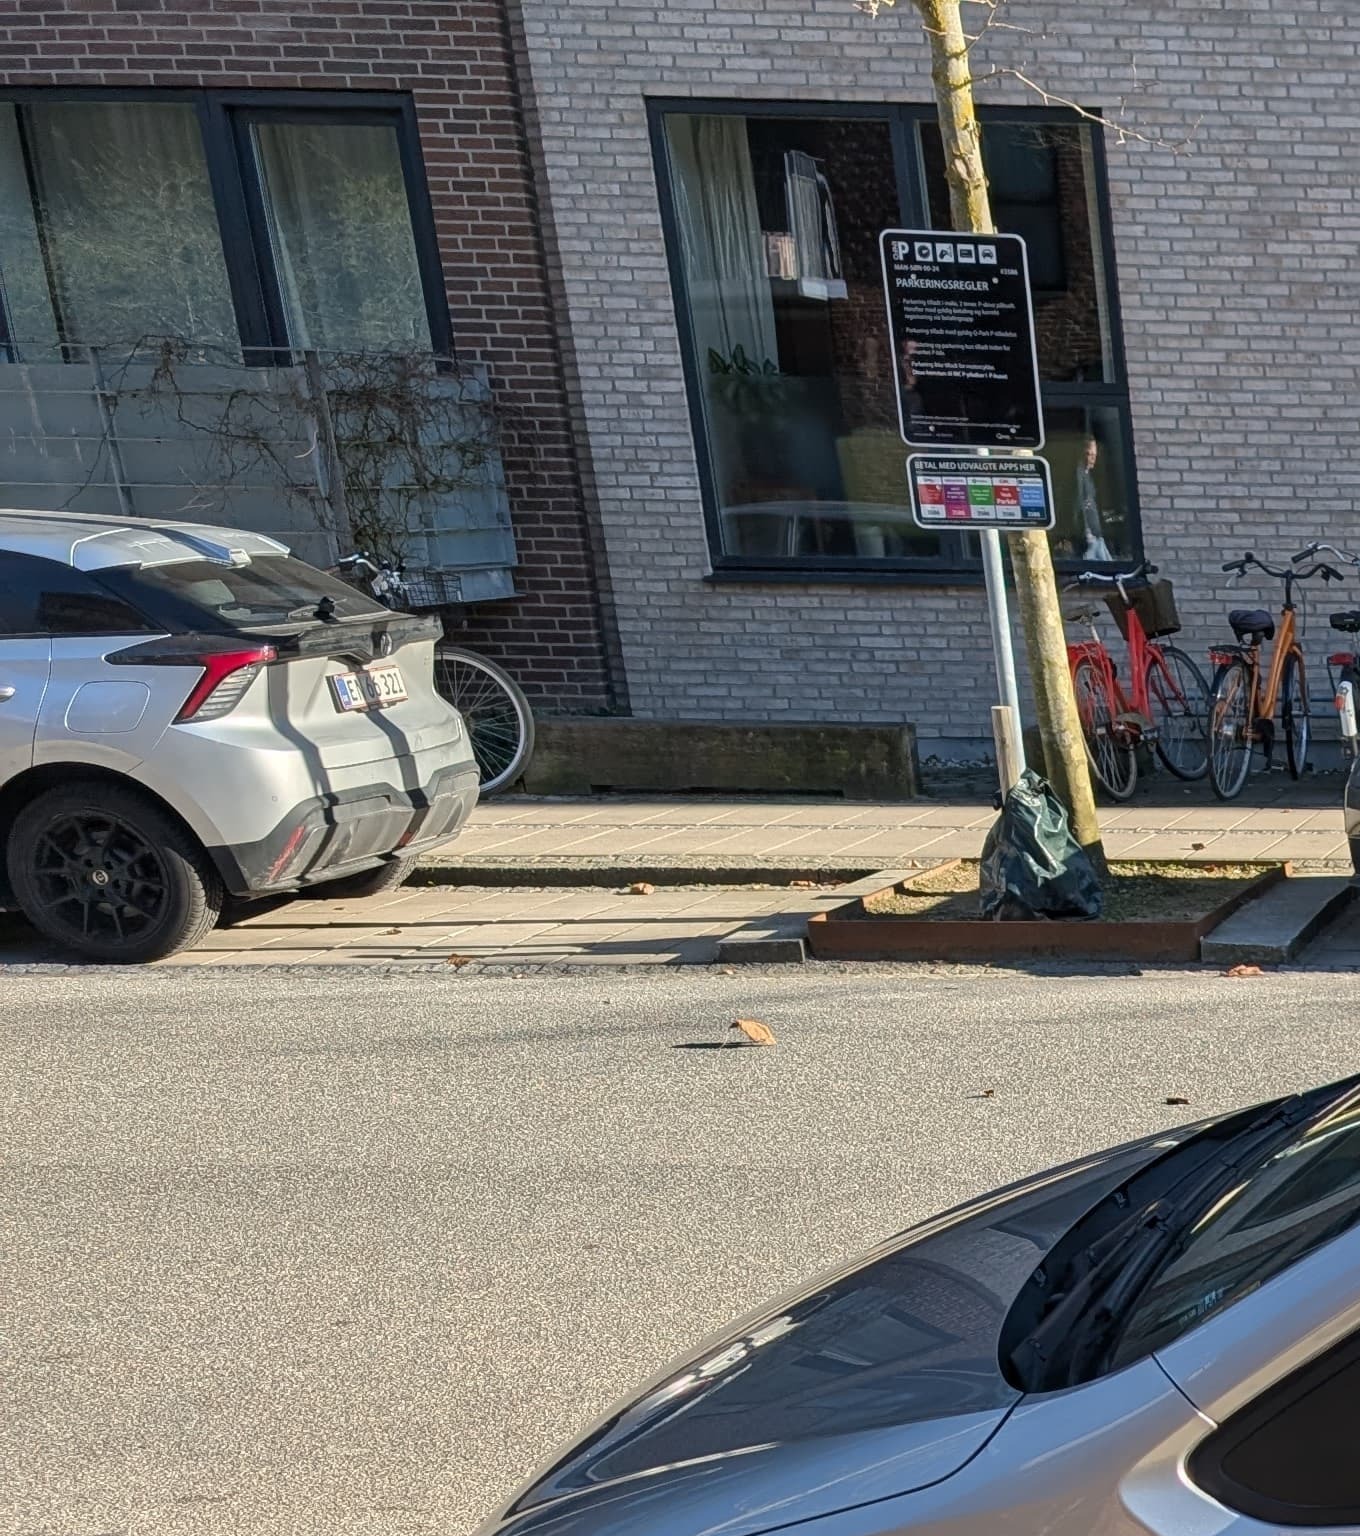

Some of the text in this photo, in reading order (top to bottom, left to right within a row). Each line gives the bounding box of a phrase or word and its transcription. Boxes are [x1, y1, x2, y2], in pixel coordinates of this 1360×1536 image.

[895, 277, 989, 291] PARKERINGSREGLER
[914, 461, 1036, 471] BETAL MED UDVALGTE APPS HER
[380, 672, 403, 696] 321
